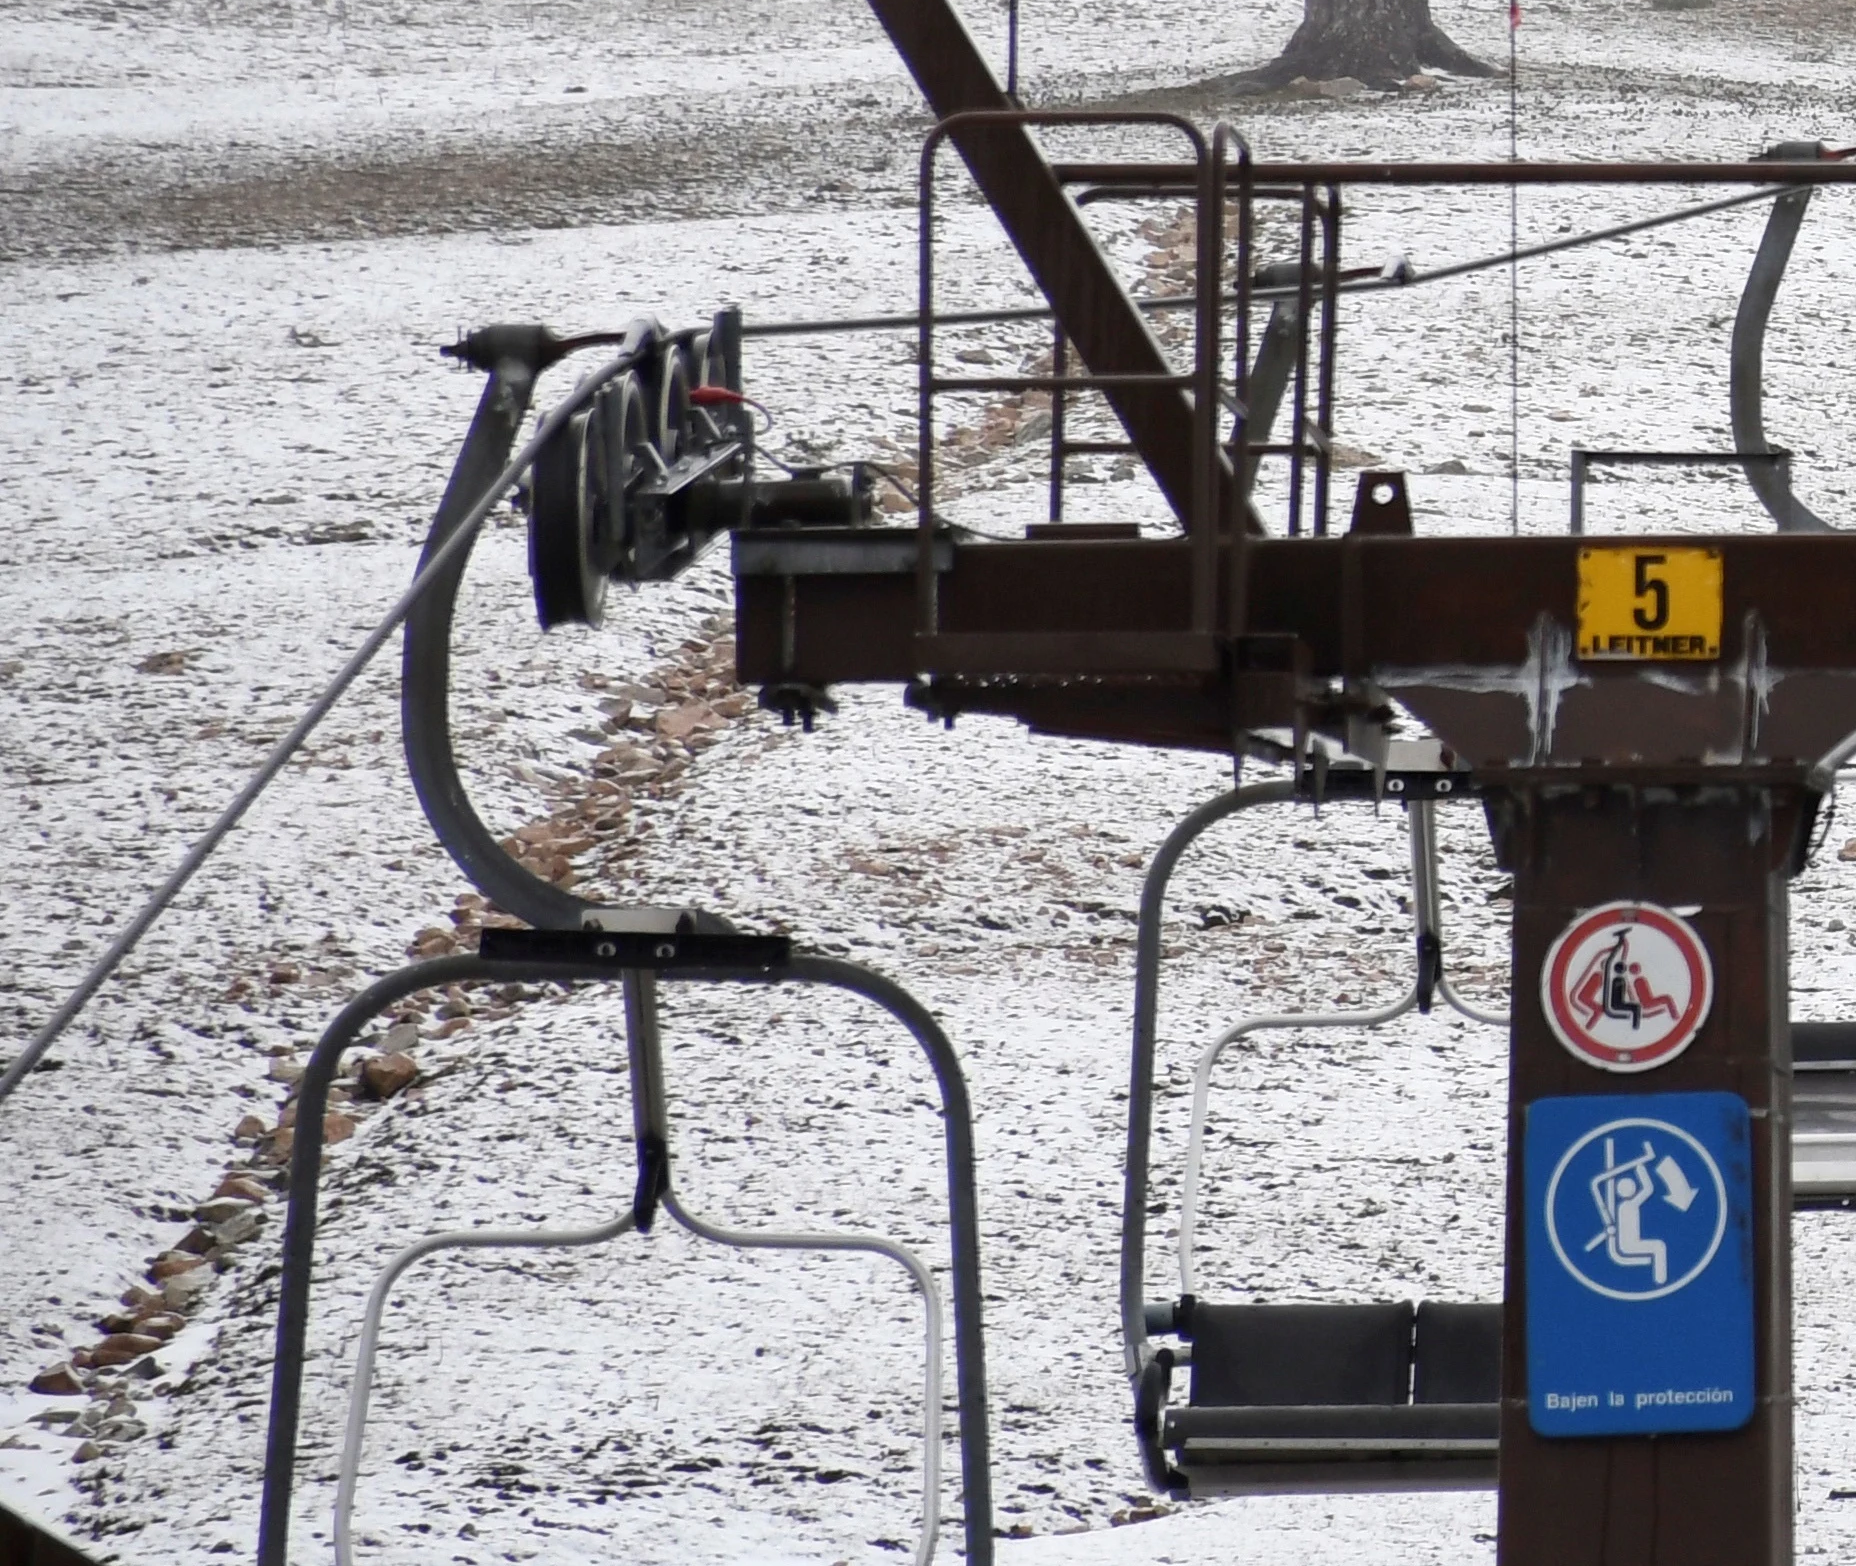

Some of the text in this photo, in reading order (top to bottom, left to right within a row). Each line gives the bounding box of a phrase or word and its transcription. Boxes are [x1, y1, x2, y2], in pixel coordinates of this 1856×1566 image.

[1633, 554, 1669, 630] 5
[1592, 635, 1706, 654] LEITNER
[1545, 1387, 1734, 1412] Bajen la protección
